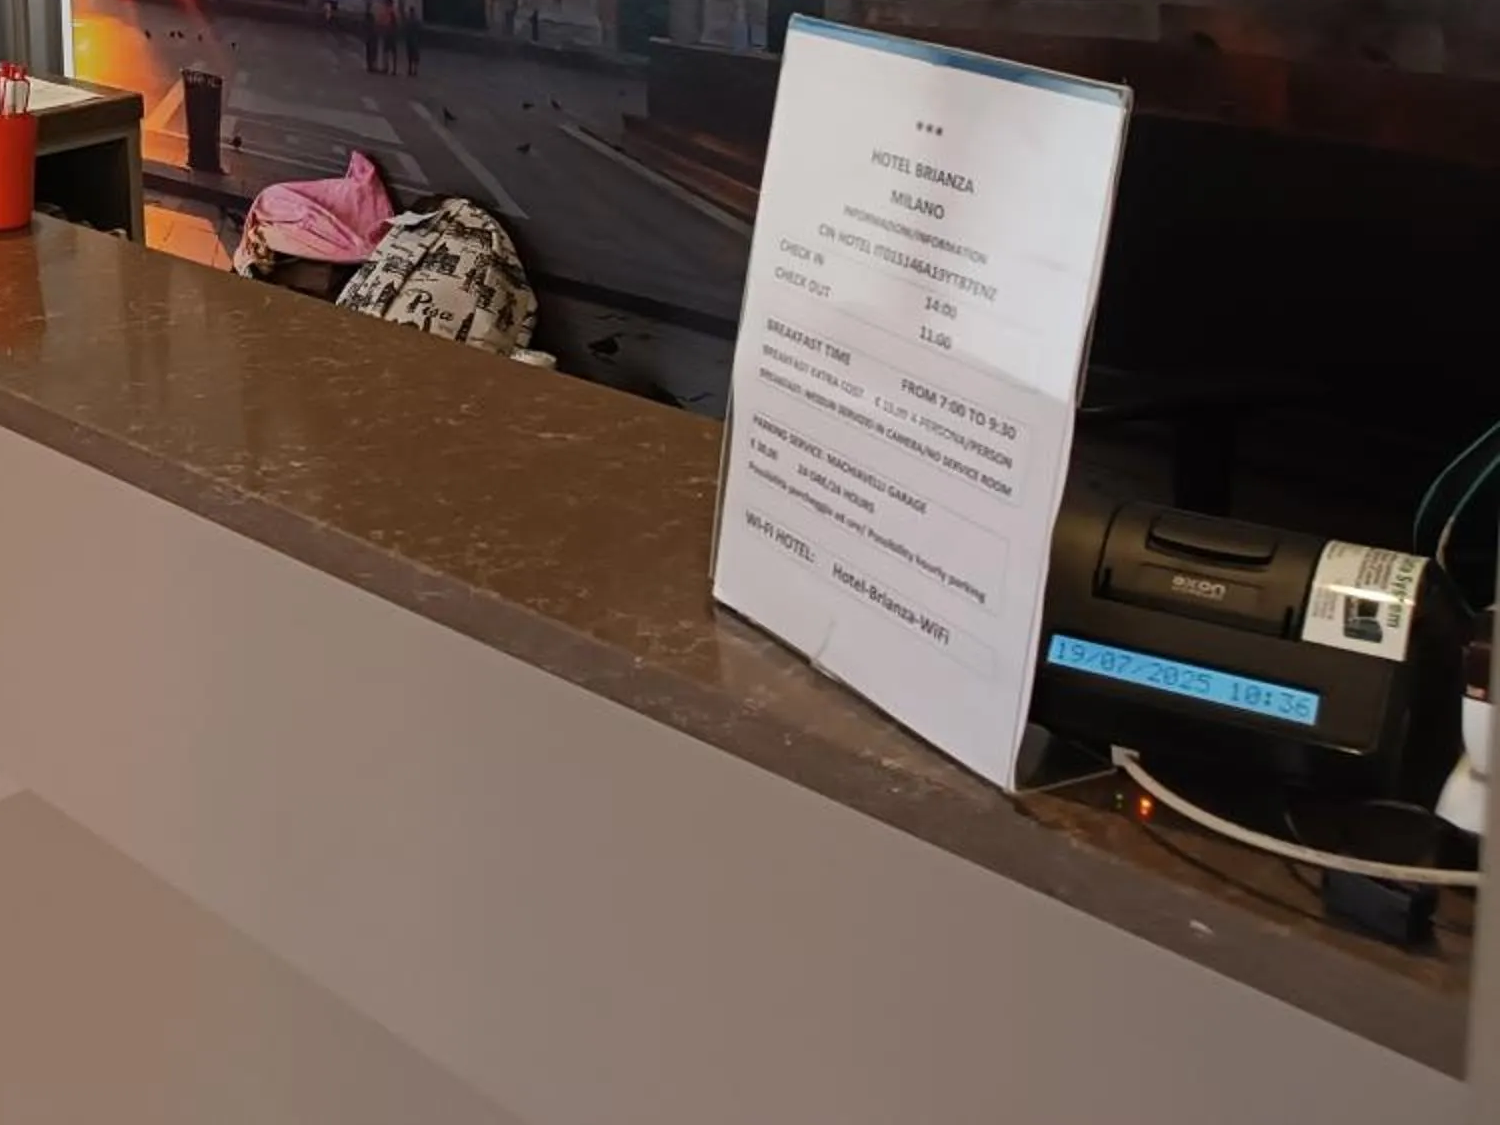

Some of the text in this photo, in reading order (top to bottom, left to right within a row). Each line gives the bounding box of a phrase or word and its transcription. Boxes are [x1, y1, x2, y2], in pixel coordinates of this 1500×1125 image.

[871, 148, 975, 194] HOTEL BRIANZA
[890, 189, 946, 220] MILANO
[779, 237, 825, 266] CHECK IN
[838, 230, 871, 256] HOTEL
[774, 265, 832, 298] CHECK OUT
[404, 290, 455, 322] Pisa
[924, 295, 958, 321] 14:00
[766, 318, 852, 367] BREAKFAST TIME
[919, 325, 952, 350] 11:00
[762, 344, 810, 373] BREAKFAST
[900, 378, 1017, 441] FROM 7:00 TO 9:30
[753, 414, 788, 442] PARKING
[888, 484, 928, 516] GARAGE
[942, 455, 979, 481] SERVICE
[980, 473, 1013, 498] ROOM
[843, 488, 876, 515] HOURS
[774, 527, 818, 565] HOTEL:
[947, 574, 987, 605] parking
[1054, 638, 1313, 720] 19/07/2025 10:36
